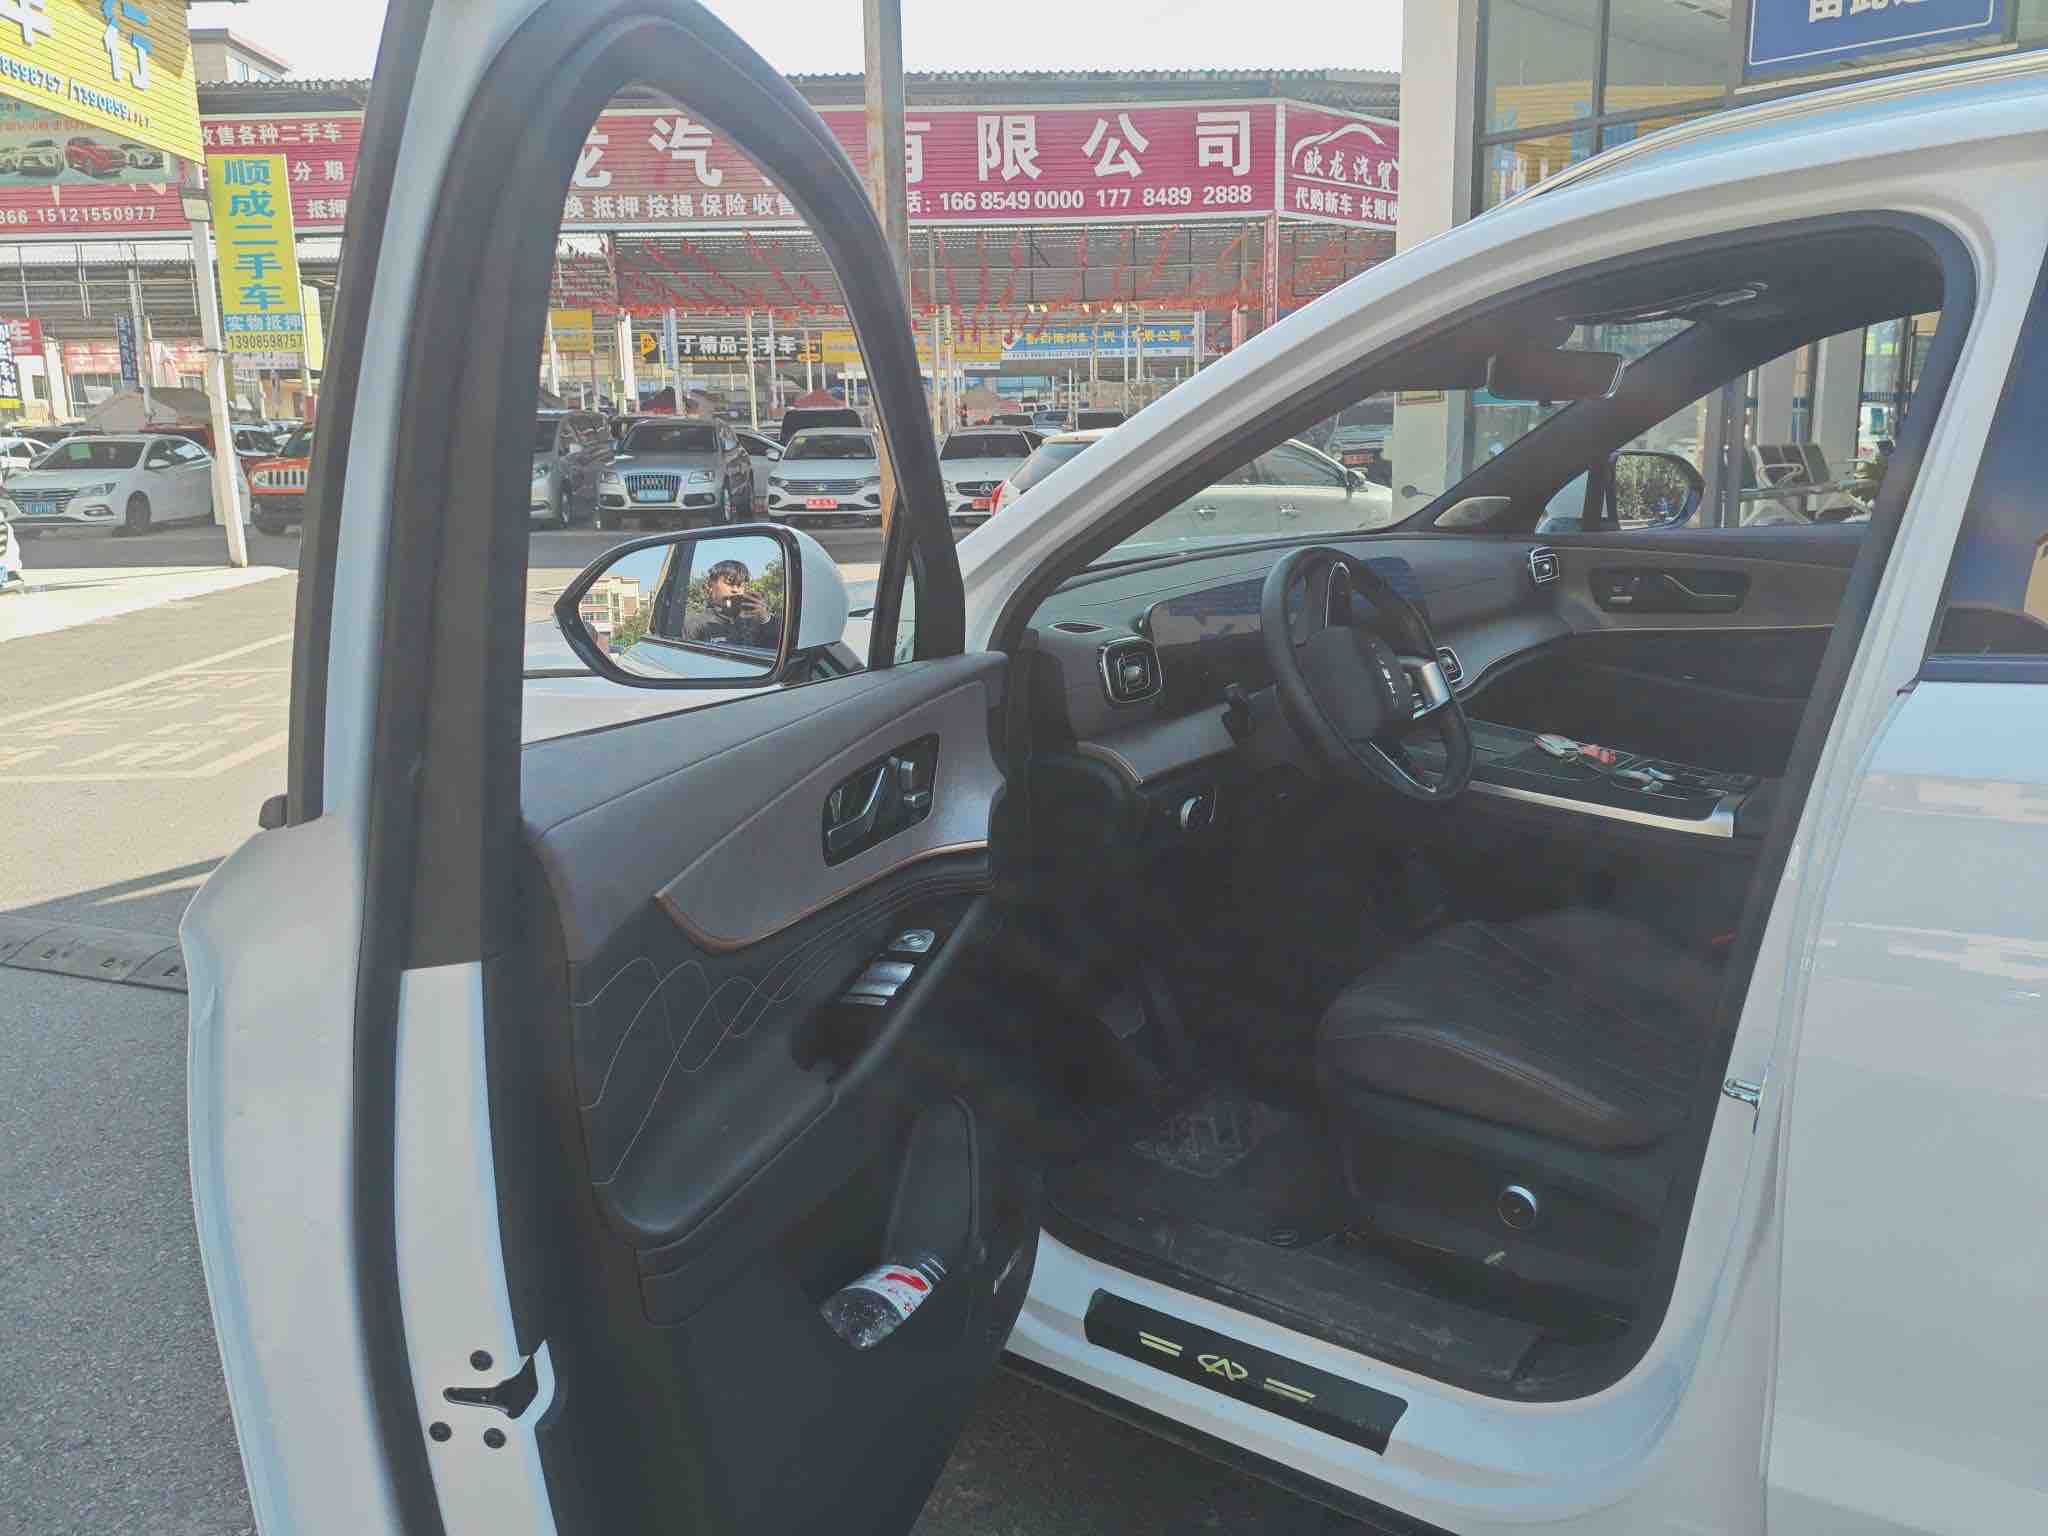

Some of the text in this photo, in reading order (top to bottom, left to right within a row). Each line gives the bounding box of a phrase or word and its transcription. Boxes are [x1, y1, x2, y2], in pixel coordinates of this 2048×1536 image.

[592, 194, 640, 219] 抵押
[647, 193, 694, 218] 按揭
[700, 193, 748, 218] 保险
[1096, 188, 1131, 208] 177
[1143, 186, 1192, 206] 8489
[1202, 184, 1252, 205] 2888
[1295, 186, 1353, 216] 代购新车
[223, 159, 287, 311] 顺成二手车
